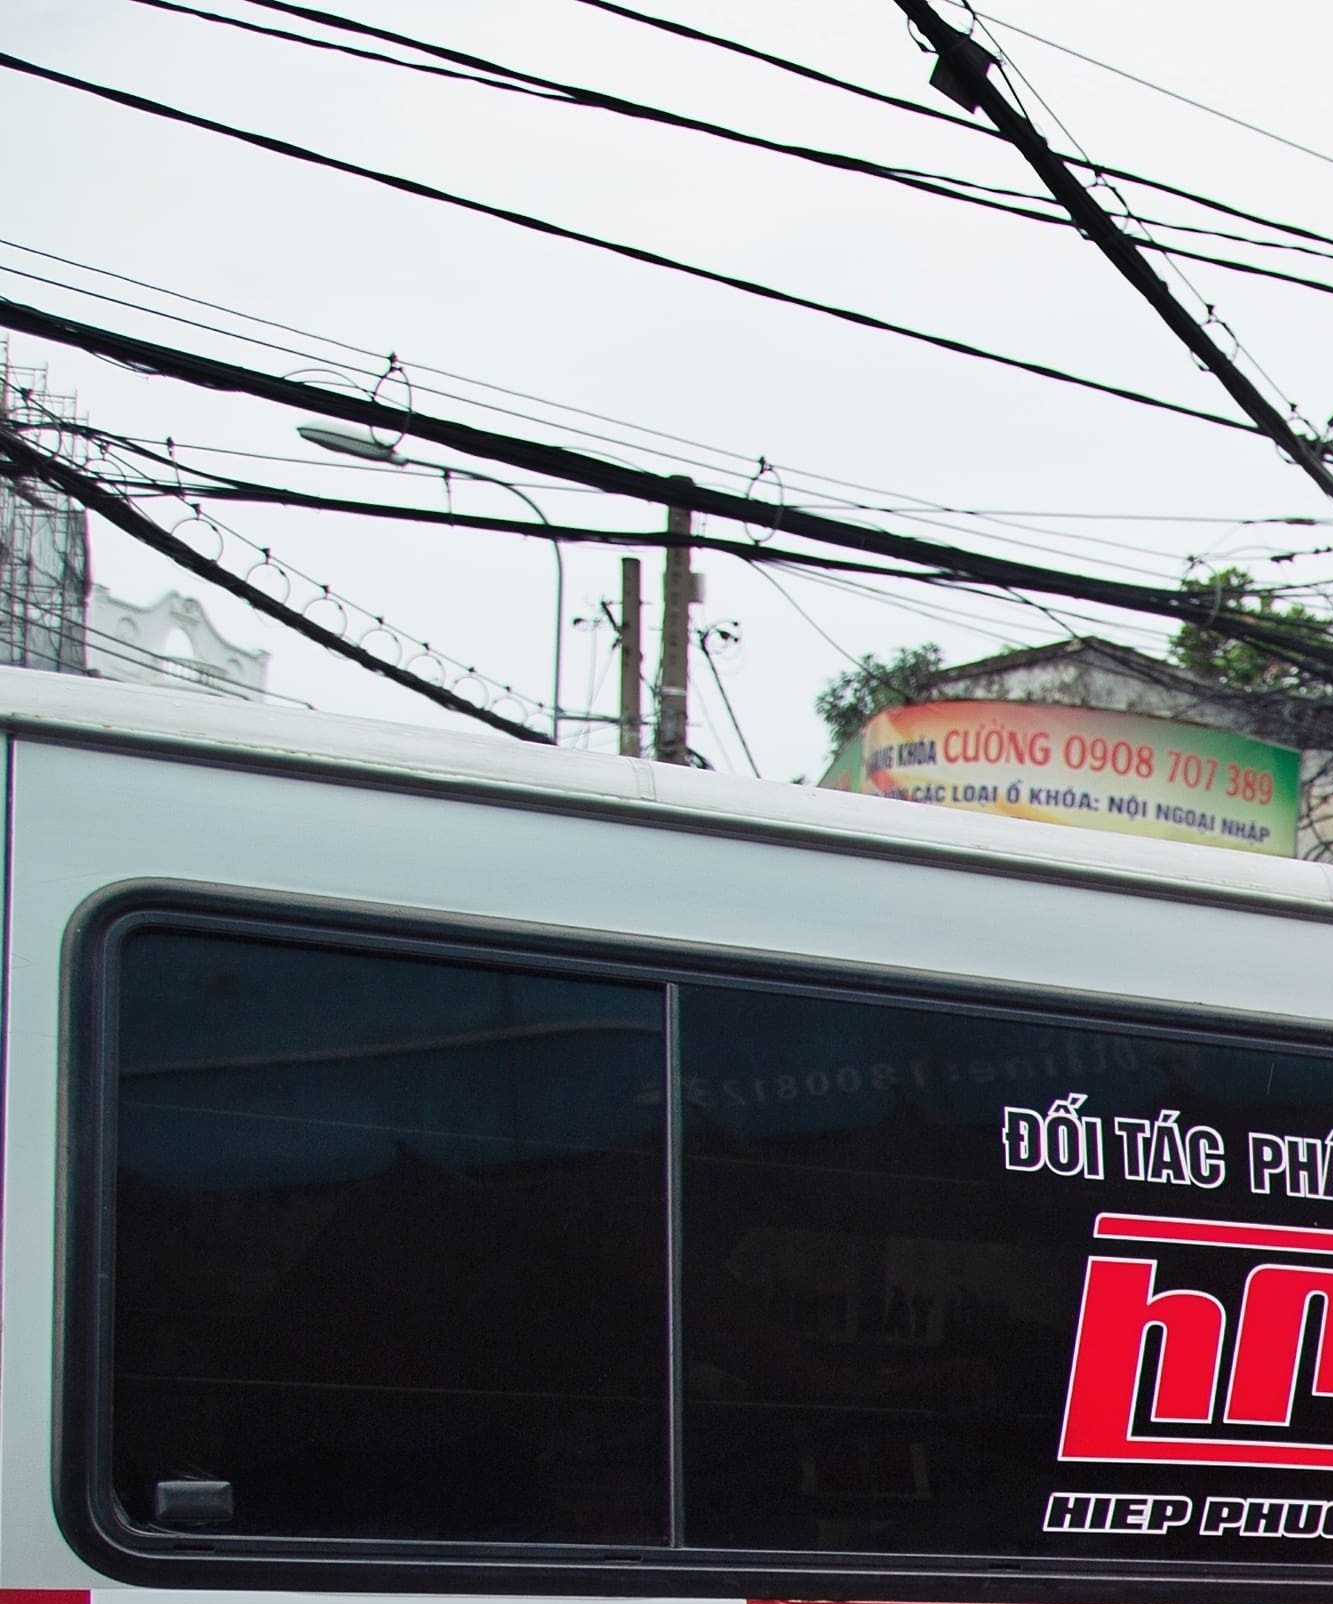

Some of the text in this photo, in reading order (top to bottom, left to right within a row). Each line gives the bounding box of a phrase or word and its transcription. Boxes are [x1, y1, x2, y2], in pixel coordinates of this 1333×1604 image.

[943, 718, 1051, 766] CƯỜNG
[1063, 734, 1154, 779] 0908
[1166, 750, 1219, 792] 707
[1224, 764, 1273, 806] 389
[952, 784, 997, 807] LOẠI
[1108, 794, 1147, 820] NỘI
[1155, 801, 1215, 834] NGOẠI
[1003, 1093, 1104, 1180] ĐỐI
[1115, 1109, 1225, 1188] TÁC
[1043, 1491, 1192, 1533] HIEP
